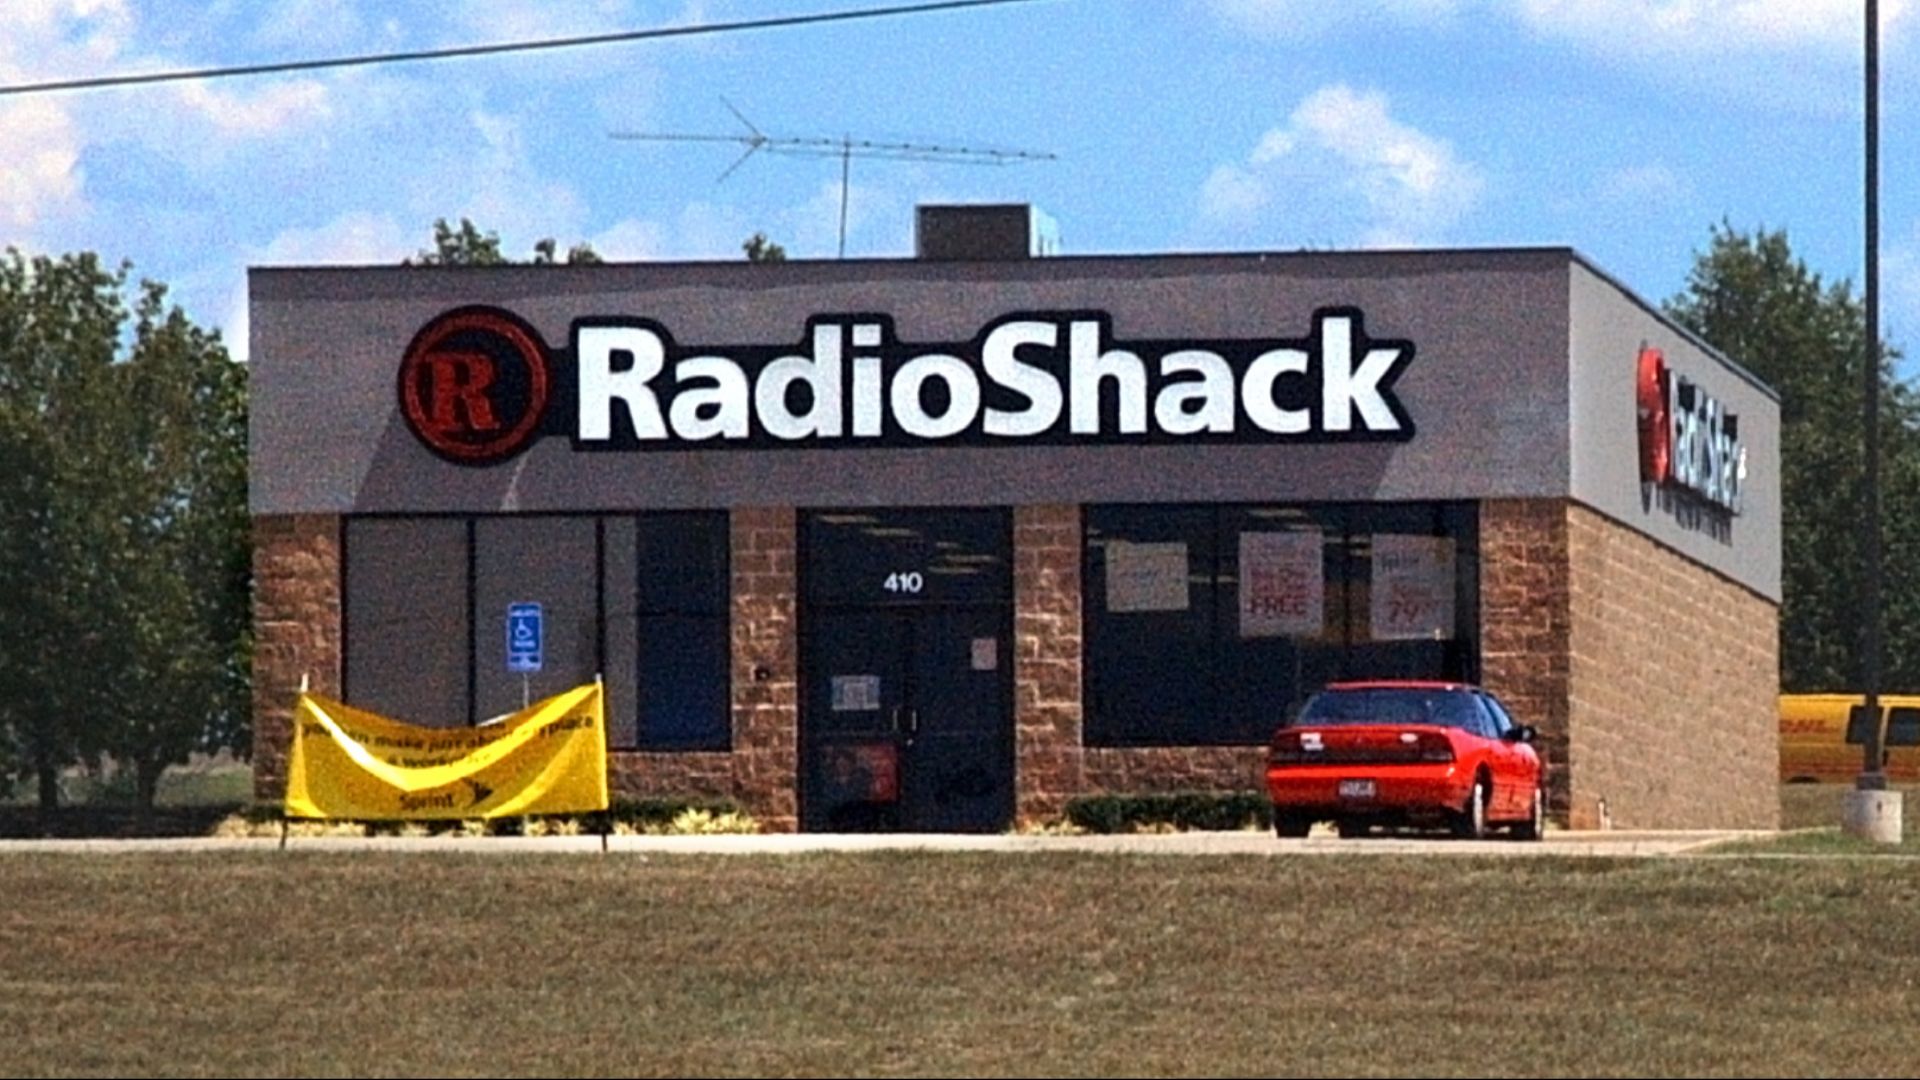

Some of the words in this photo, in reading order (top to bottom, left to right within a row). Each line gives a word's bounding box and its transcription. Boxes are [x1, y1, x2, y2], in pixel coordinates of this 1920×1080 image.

[423, 352, 501, 431] R
[577, 317, 1400, 440] RadioShack
[884, 572, 923, 592] 410
[374, 735, 423, 749] make
[399, 790, 455, 813] Sprint
